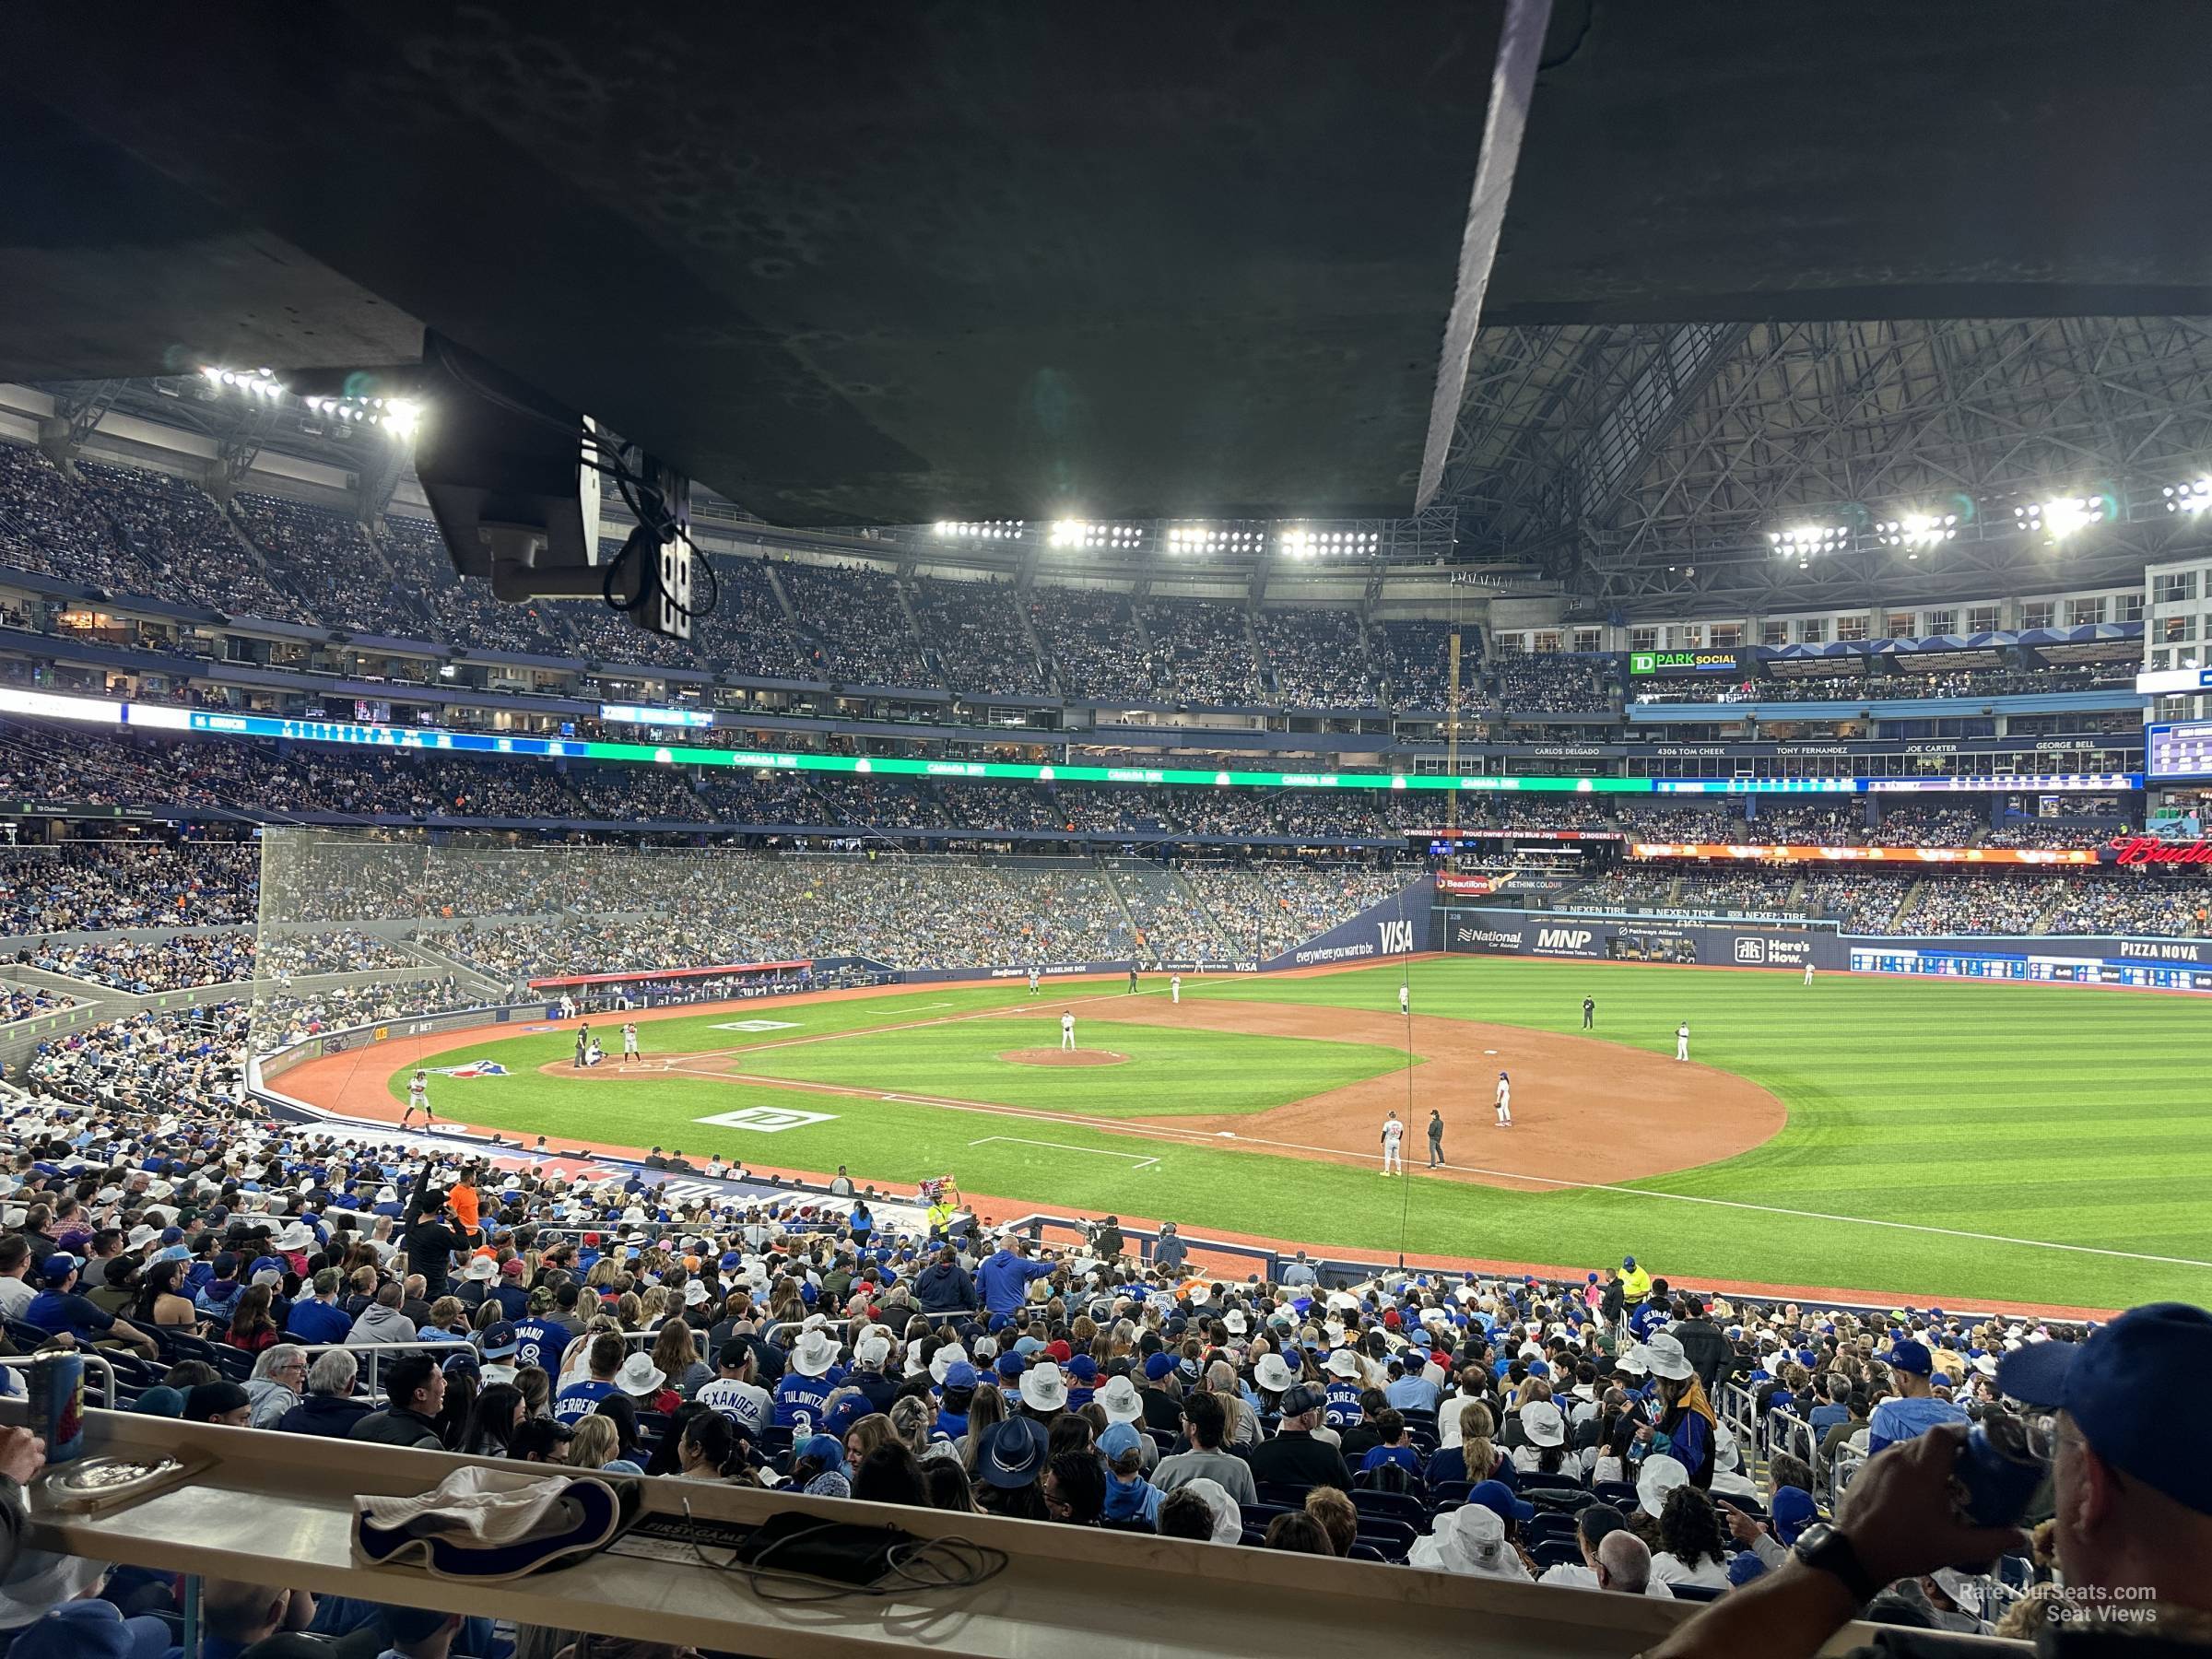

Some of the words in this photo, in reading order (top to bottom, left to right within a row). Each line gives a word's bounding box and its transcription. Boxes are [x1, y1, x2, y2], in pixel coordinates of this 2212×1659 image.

[1633, 656, 1653, 670] TD
[1657, 653, 1695, 665] PARK
[1696, 655, 1736, 665] SOCIAL
[1565, 747, 1600, 756] DELGADO
[1699, 747, 1725, 756] CHEEK
[1801, 747, 1848, 755] FERNANDEZ
[1925, 745, 1957, 753] CARTER
[2036, 742, 2072, 750] GEORGE
[926, 764, 967, 775] CANADA
[1108, 770, 1144, 781] CANADA
[1281, 775, 1319, 786] CANADA
[1461, 778, 1499, 789] CANADA
[1447, 880, 1488, 889] BeautiTone
[1570, 905, 1603, 913] NEXEN
[1604, 906, 1627, 914] TIRE
[1656, 908, 1689, 917] NEXEN
[1692, 910, 1715, 918] TIRE
[1746, 911, 1779, 920] NEXEN
[1783, 912, 1806, 921] TIRE
[1377, 921, 1414, 954] VISA
[1629, 928, 1657, 936] Pathways
[1658, 928, 1683, 936] Alliance
[1537, 929, 1593, 948] MNP
[1296, 946, 1334, 964] everywhere
[1333, 947, 1345, 961] you
[1345, 944, 1359, 956] want
[1359, 944, 1366, 955] to
[1365, 942, 1373, 955] be
[2121, 942, 2159, 958] PIZZA
[2161, 945, 2198, 960] NOVA
[1769, 952, 1803, 964] How.
[1138, 961, 1163, 971] VA
[1234, 962, 1257, 971] VISA
[729, 1110, 812, 1125] TD
[515, 1326, 545, 1341] OMANO
[515, 1343, 540, 1367] 8
[784, 1391, 826, 1409] TULOWITZ
[1325, 1392, 1360, 1406] ERRER
[554, 1398, 599, 1418] GUERRER
[702, 1391, 759, 1419] EXANDER
[645, 1523, 691, 1535] FIRST
[695, 1527, 747, 1543] GAME
